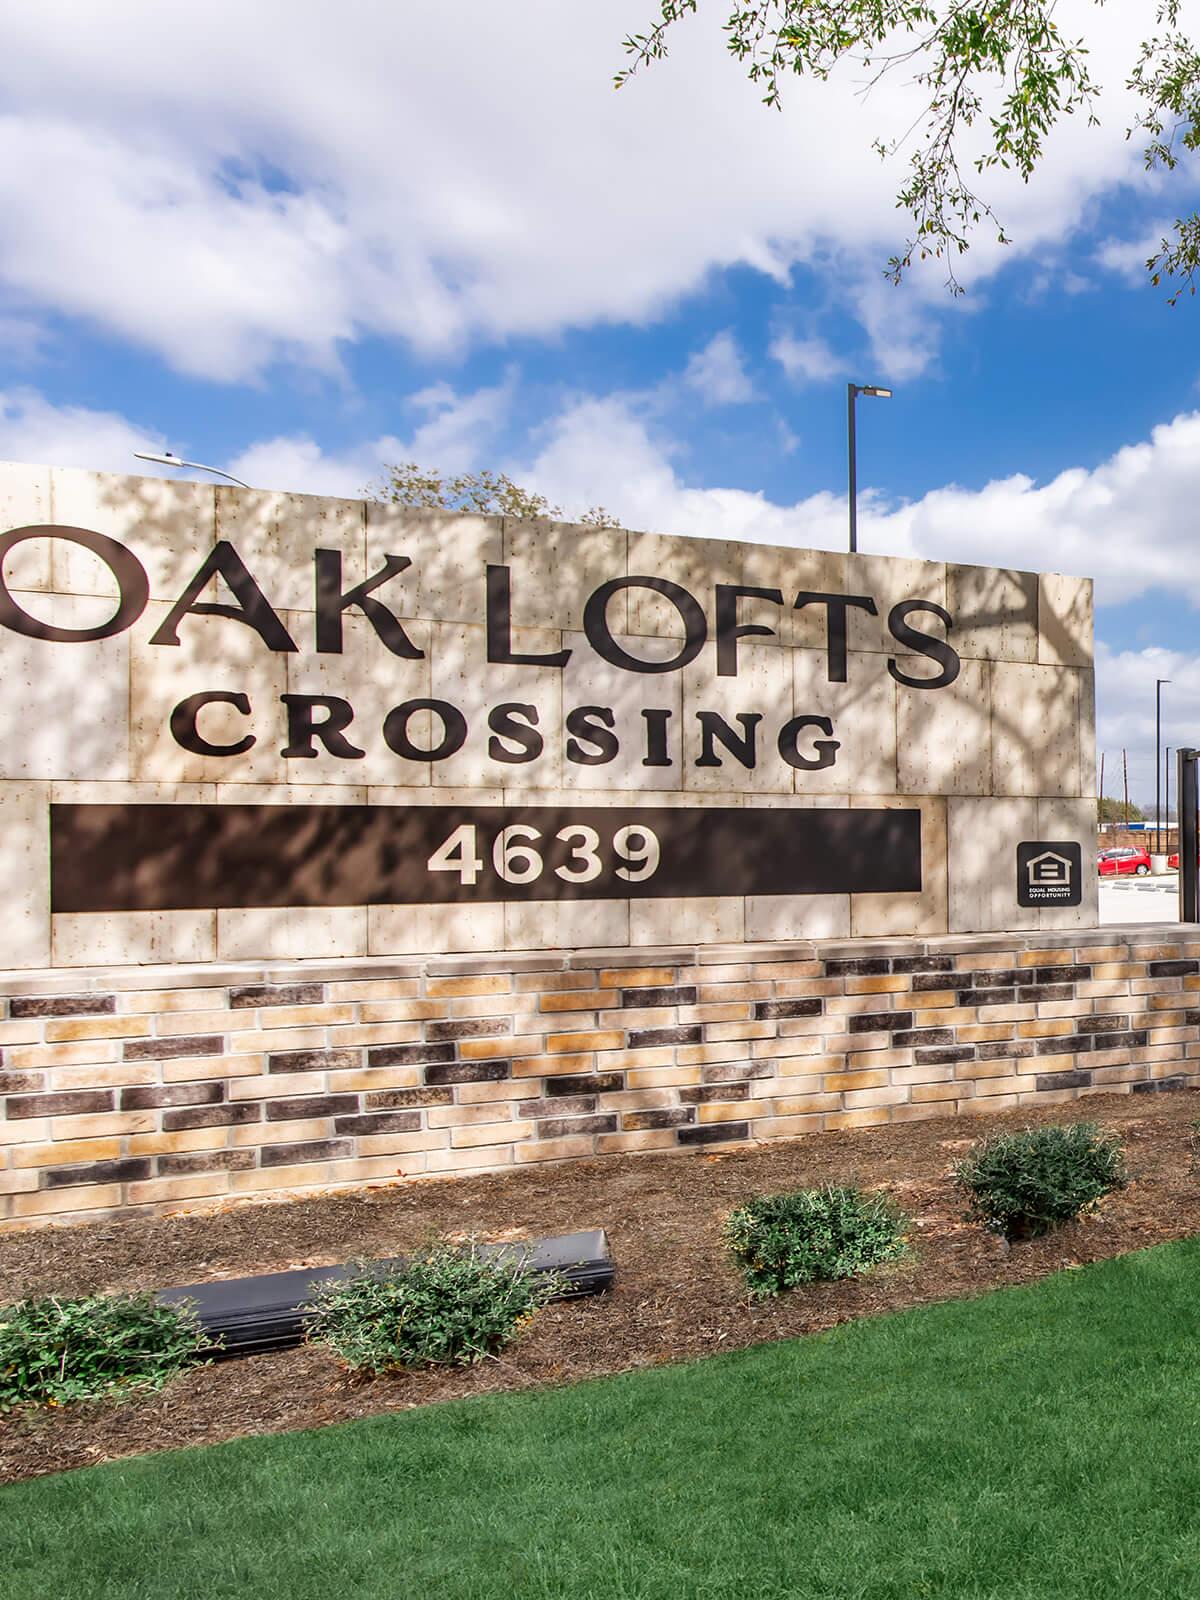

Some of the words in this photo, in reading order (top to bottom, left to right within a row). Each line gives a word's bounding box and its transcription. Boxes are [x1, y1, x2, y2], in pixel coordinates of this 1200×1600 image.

[0, 525, 425, 660] OAK
[487, 564, 961, 689] LOFTS
[170, 690, 841, 771] CROSSING
[427, 823, 661, 885] 4639
